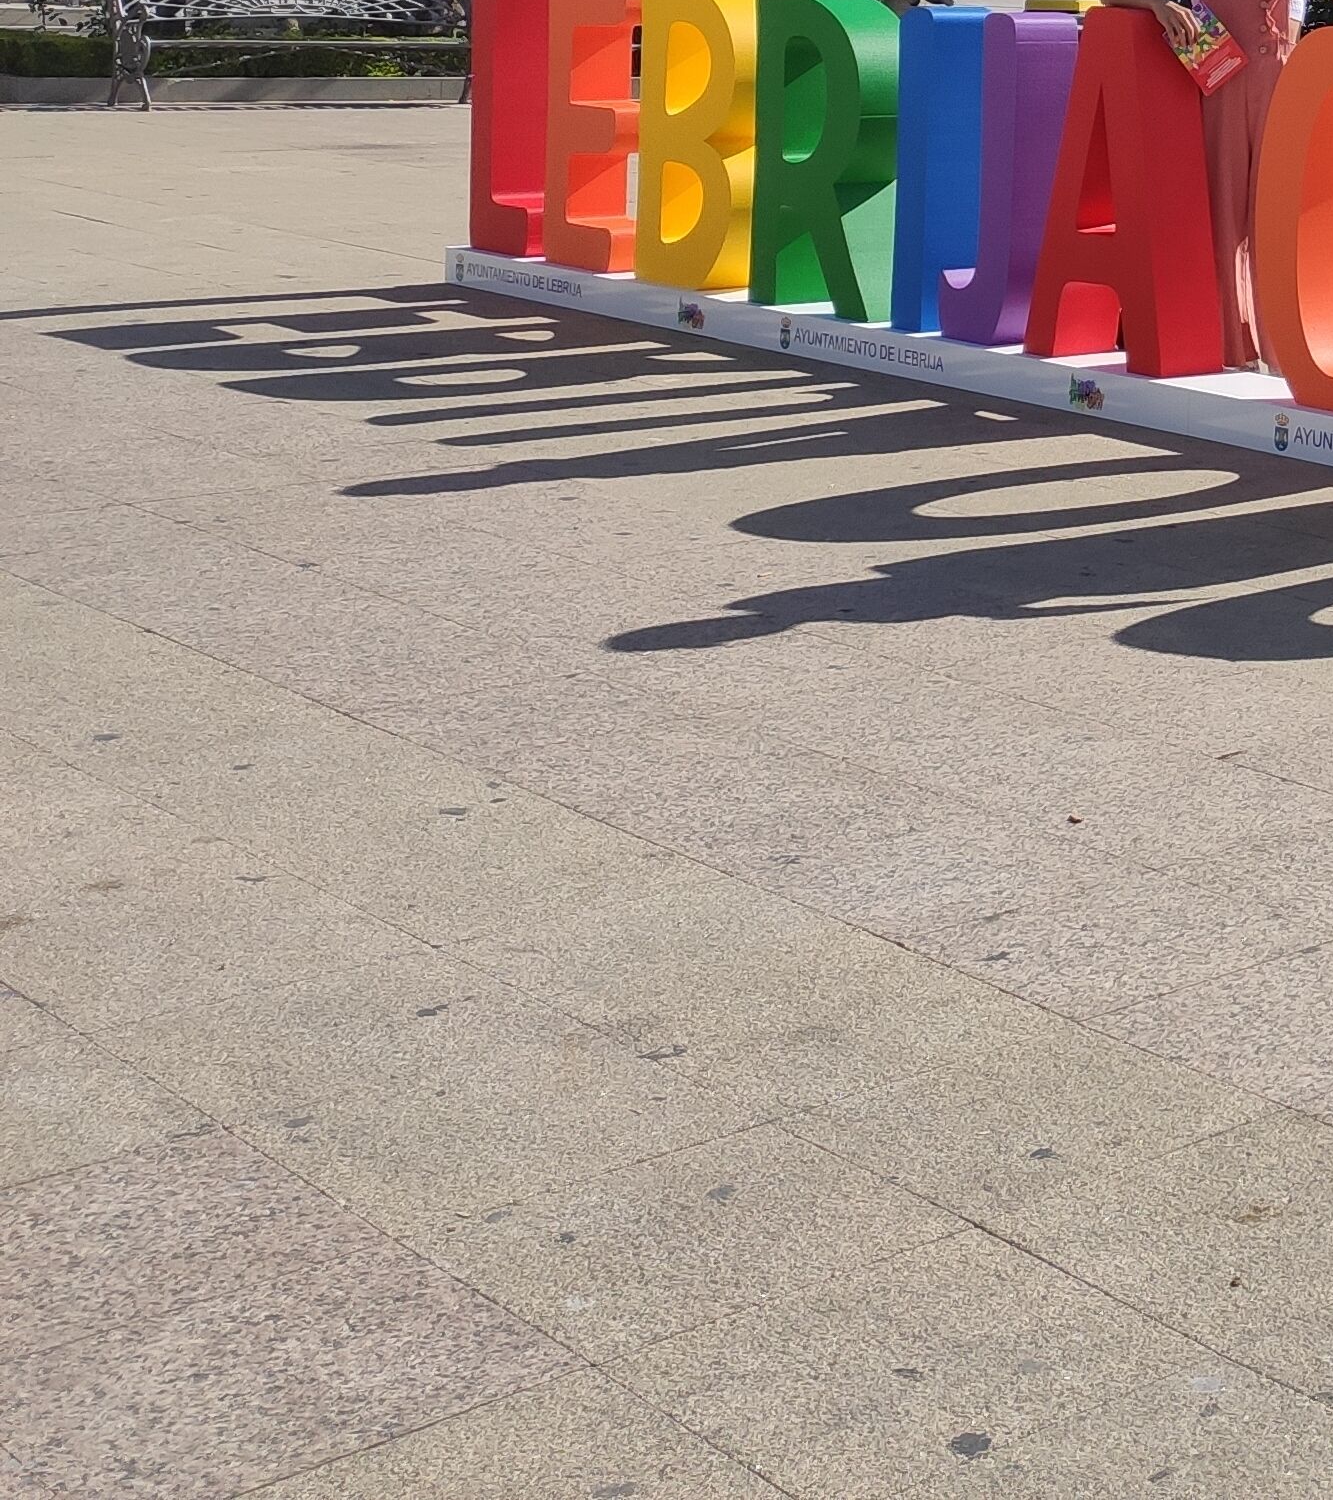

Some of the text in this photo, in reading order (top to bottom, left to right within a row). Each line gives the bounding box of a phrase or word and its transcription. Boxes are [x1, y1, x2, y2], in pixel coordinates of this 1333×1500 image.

[466, 262, 583, 298] AYUNTAMIENTO DE LEBRIJA
[793, 327, 944, 373] AYUNTAMIENTO DE LEBRIJA
